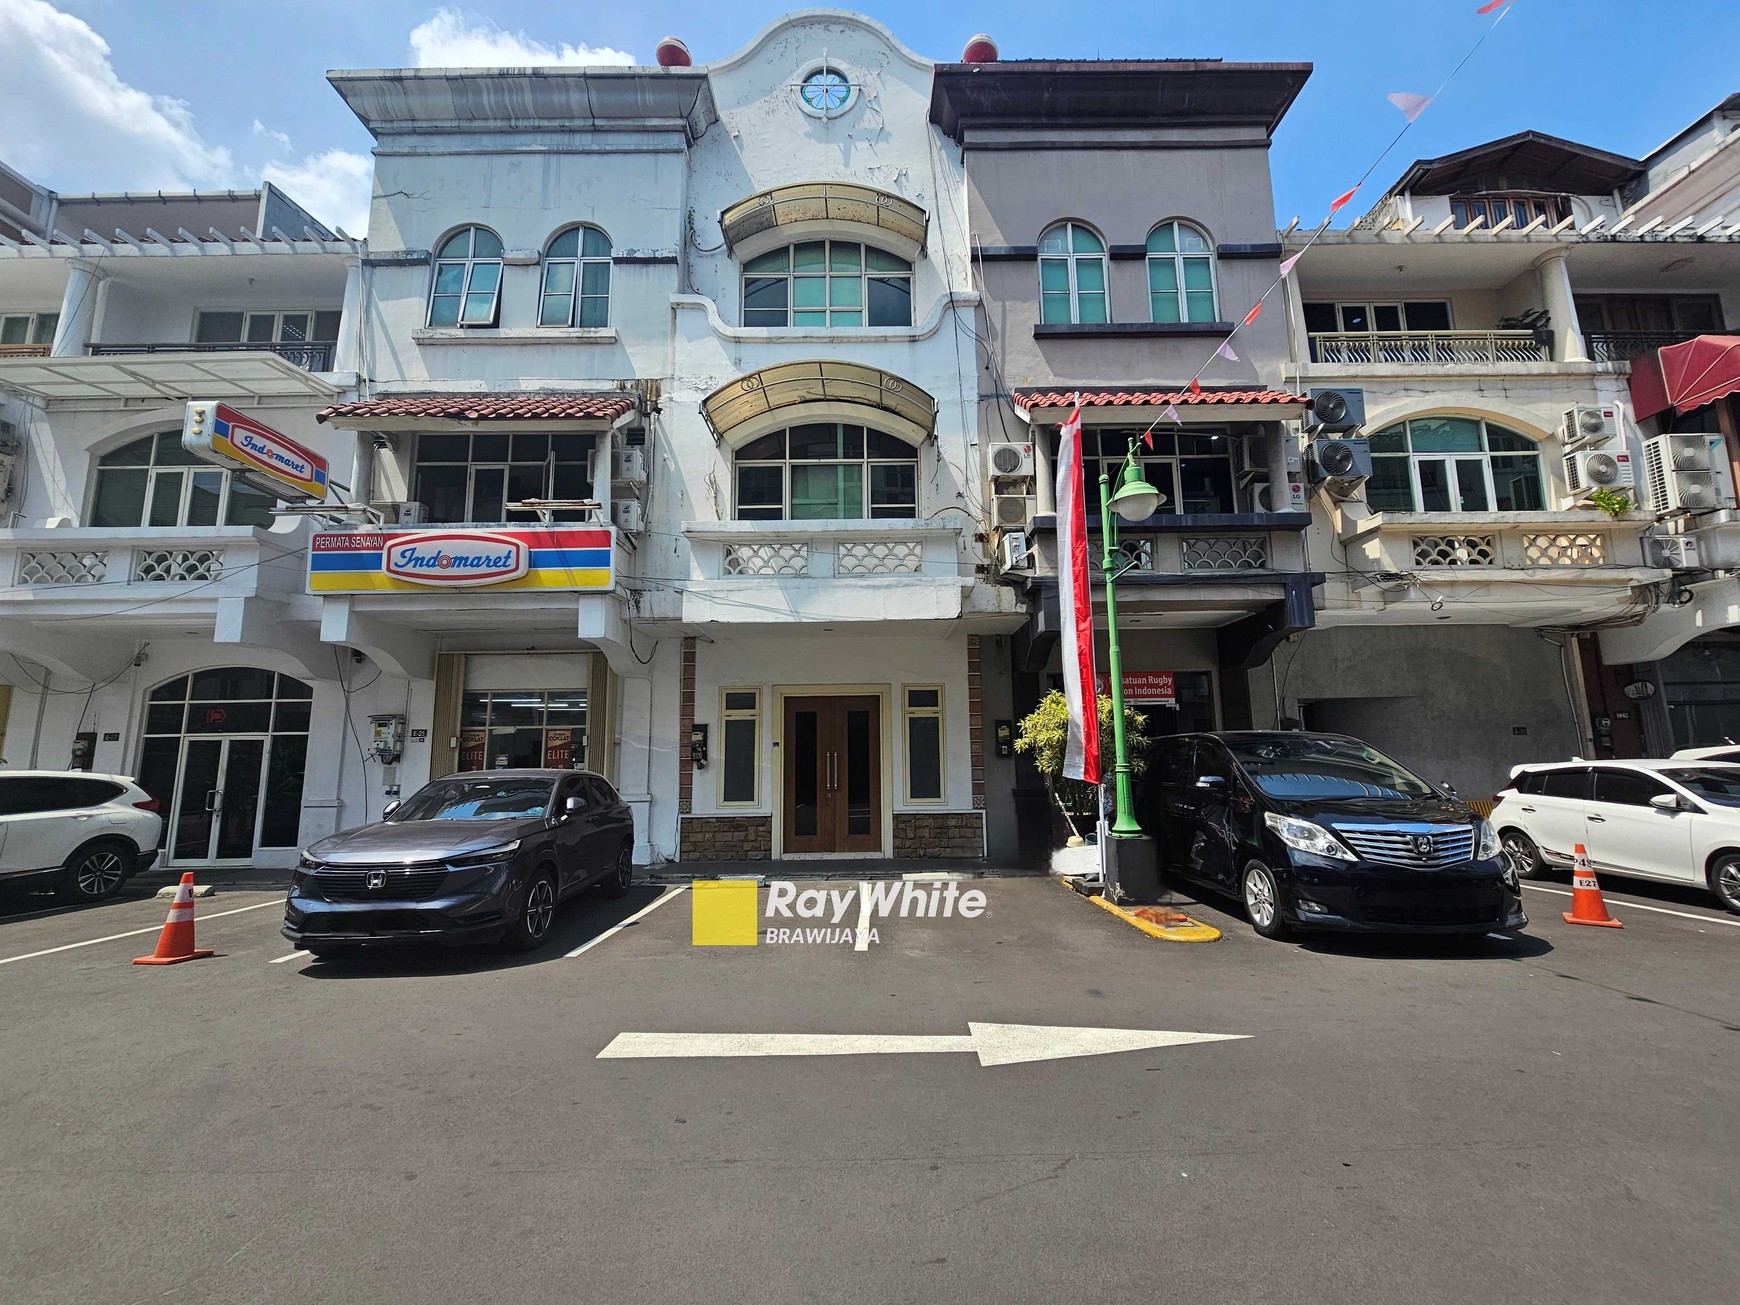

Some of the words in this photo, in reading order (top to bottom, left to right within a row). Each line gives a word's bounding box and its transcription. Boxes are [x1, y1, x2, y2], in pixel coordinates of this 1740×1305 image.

[240, 435, 306, 474] Indomaret
[315, 537, 350, 549] PERMATA
[352, 536, 384, 548] SENAYAN
[394, 547, 513, 571] Indomaret
[1148, 675, 1173, 686] Rugby
[1135, 686, 1172, 695] Indonesia
[461, 751, 484, 761] ELITE
[547, 749, 570, 760] ELITE
